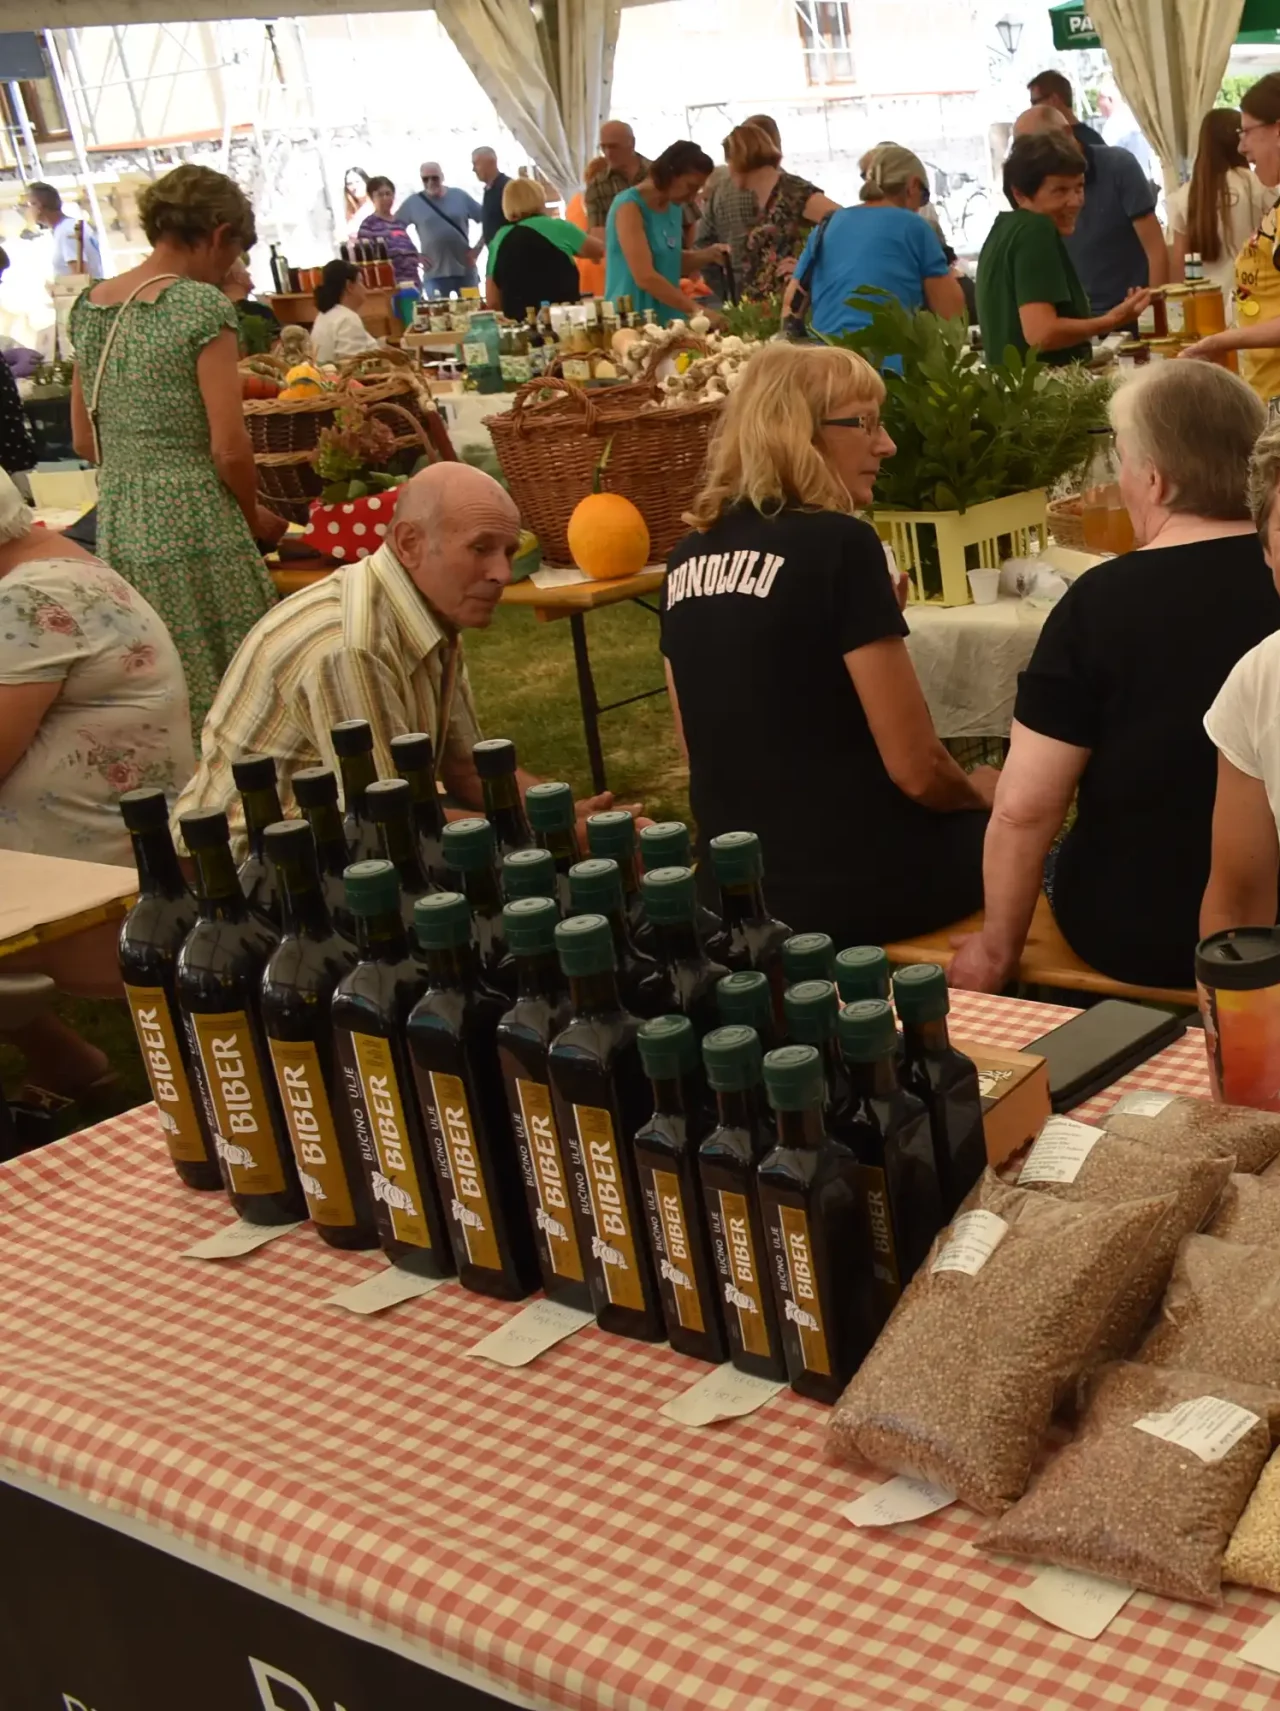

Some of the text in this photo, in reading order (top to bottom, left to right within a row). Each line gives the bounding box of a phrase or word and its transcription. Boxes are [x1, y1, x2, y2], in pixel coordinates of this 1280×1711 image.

[666, 550, 785, 611] HONOLULU
[138, 1006, 180, 1102] BIBER
[211, 1033, 259, 1134] BIBER
[343, 1066, 359, 1099] ULJE
[283, 1063, 327, 1165] BIBER
[369, 1075, 406, 1171] BIBER
[426, 1105, 440, 1131] ULJE
[512, 1112, 527, 1139] ULJE
[446, 1105, 482, 1199] BIBER
[531, 1115, 566, 1209] BIBER
[568, 1138, 581, 1165] ULJE
[589, 1140, 626, 1236] BIBER
[646, 1189, 656, 1211] ULJE
[663, 1195, 687, 1260] BIBER
[711, 1211, 721, 1234] ULJE
[729, 1217, 754, 1282] BIBER
[771, 1226, 781, 1249] ULJE
[867, 1190, 890, 1253] BIBER
[789, 1233, 814, 1300] BIBER
